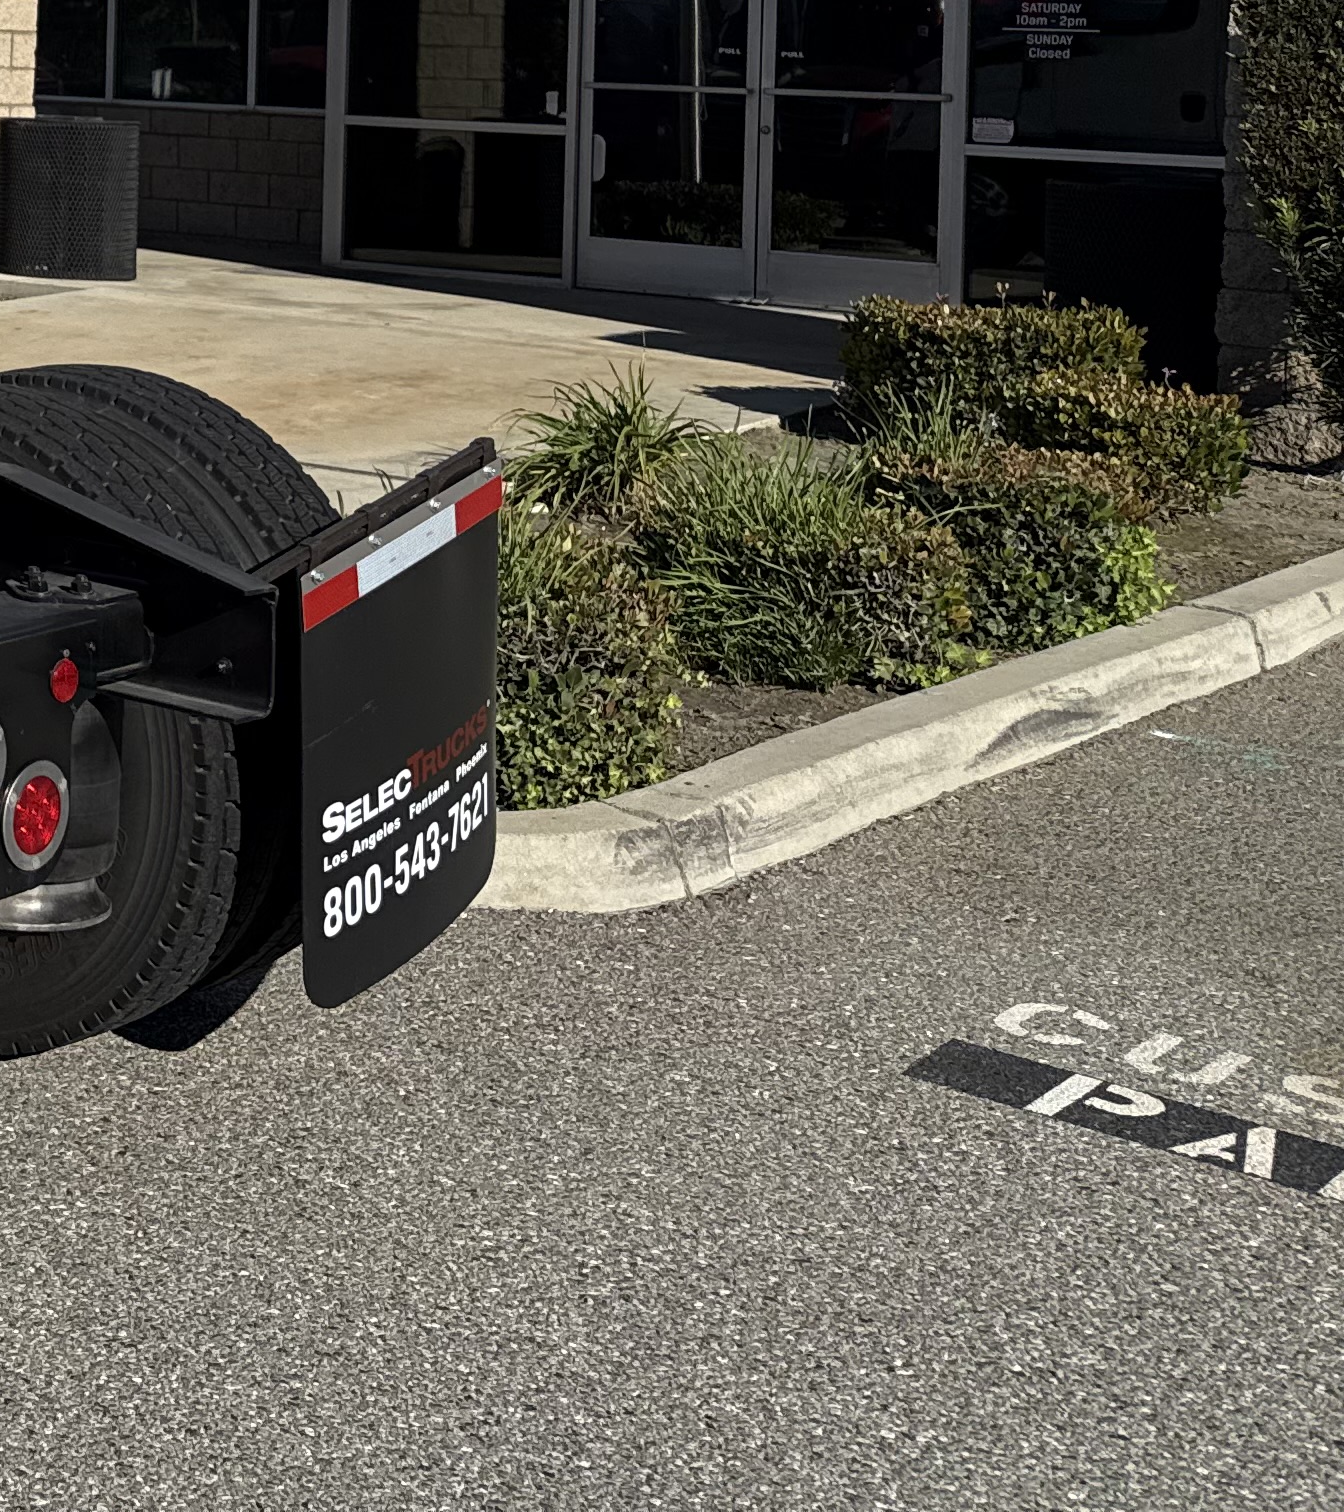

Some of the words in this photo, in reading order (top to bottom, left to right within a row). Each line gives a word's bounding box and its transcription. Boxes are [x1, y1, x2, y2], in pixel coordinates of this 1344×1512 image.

[1021, 2, 1082, 14] SATURDAY
[1015, 14, 1048, 26] 10am
[1059, 15, 1087, 27] 2pm
[1025, 34, 1074, 45] SUNDAY
[1028, 47, 1071, 59] Closed
[322, 847, 348, 874] Los
[351, 818, 401, 859] Angeles
[408, 780, 450, 822] Fontana
[455, 742, 488, 784] Phoenix
[323, 772, 489, 938] 800-543-7621
[1024, 1073, 1344, 1202] PA
